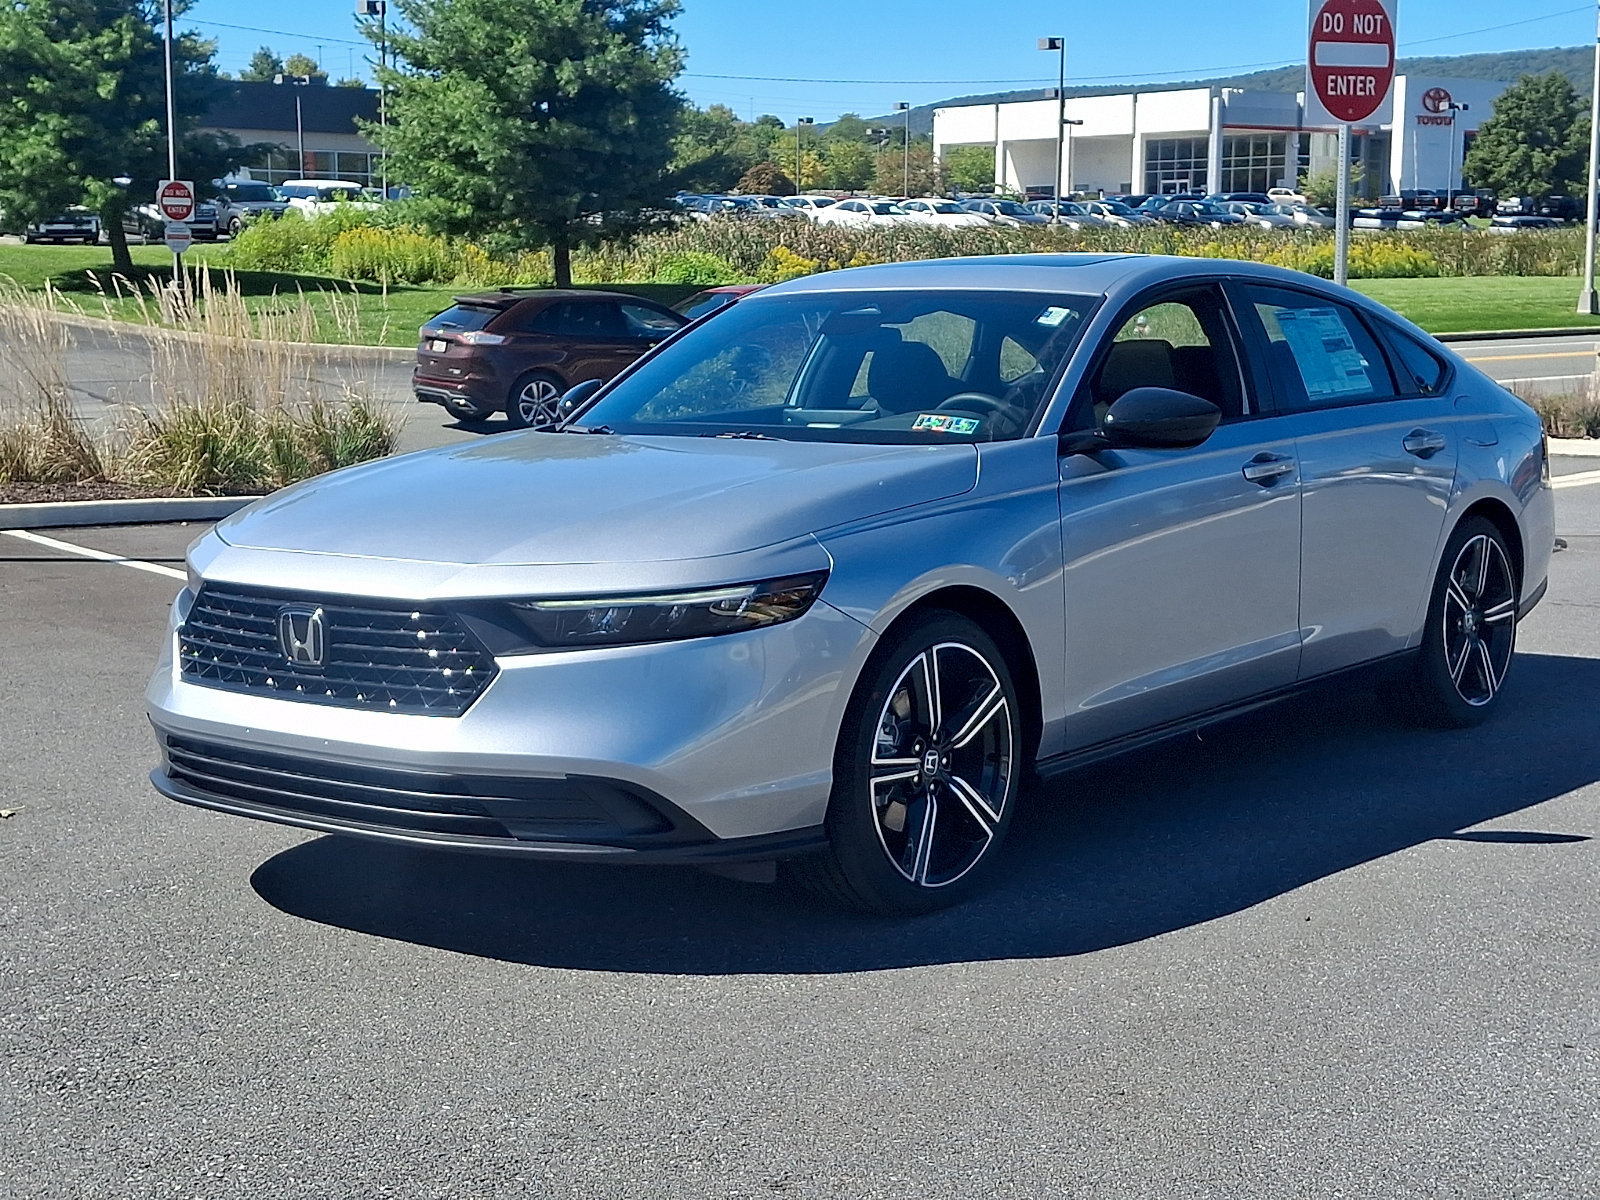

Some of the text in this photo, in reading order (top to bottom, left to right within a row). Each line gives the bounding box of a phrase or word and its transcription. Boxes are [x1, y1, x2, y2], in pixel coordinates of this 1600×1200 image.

[1322, 12, 1384, 35] DO NOT
[1327, 74, 1376, 96] ENTER
[164, 188, 174, 196] DO
[167, 206, 187, 214] ENTER
